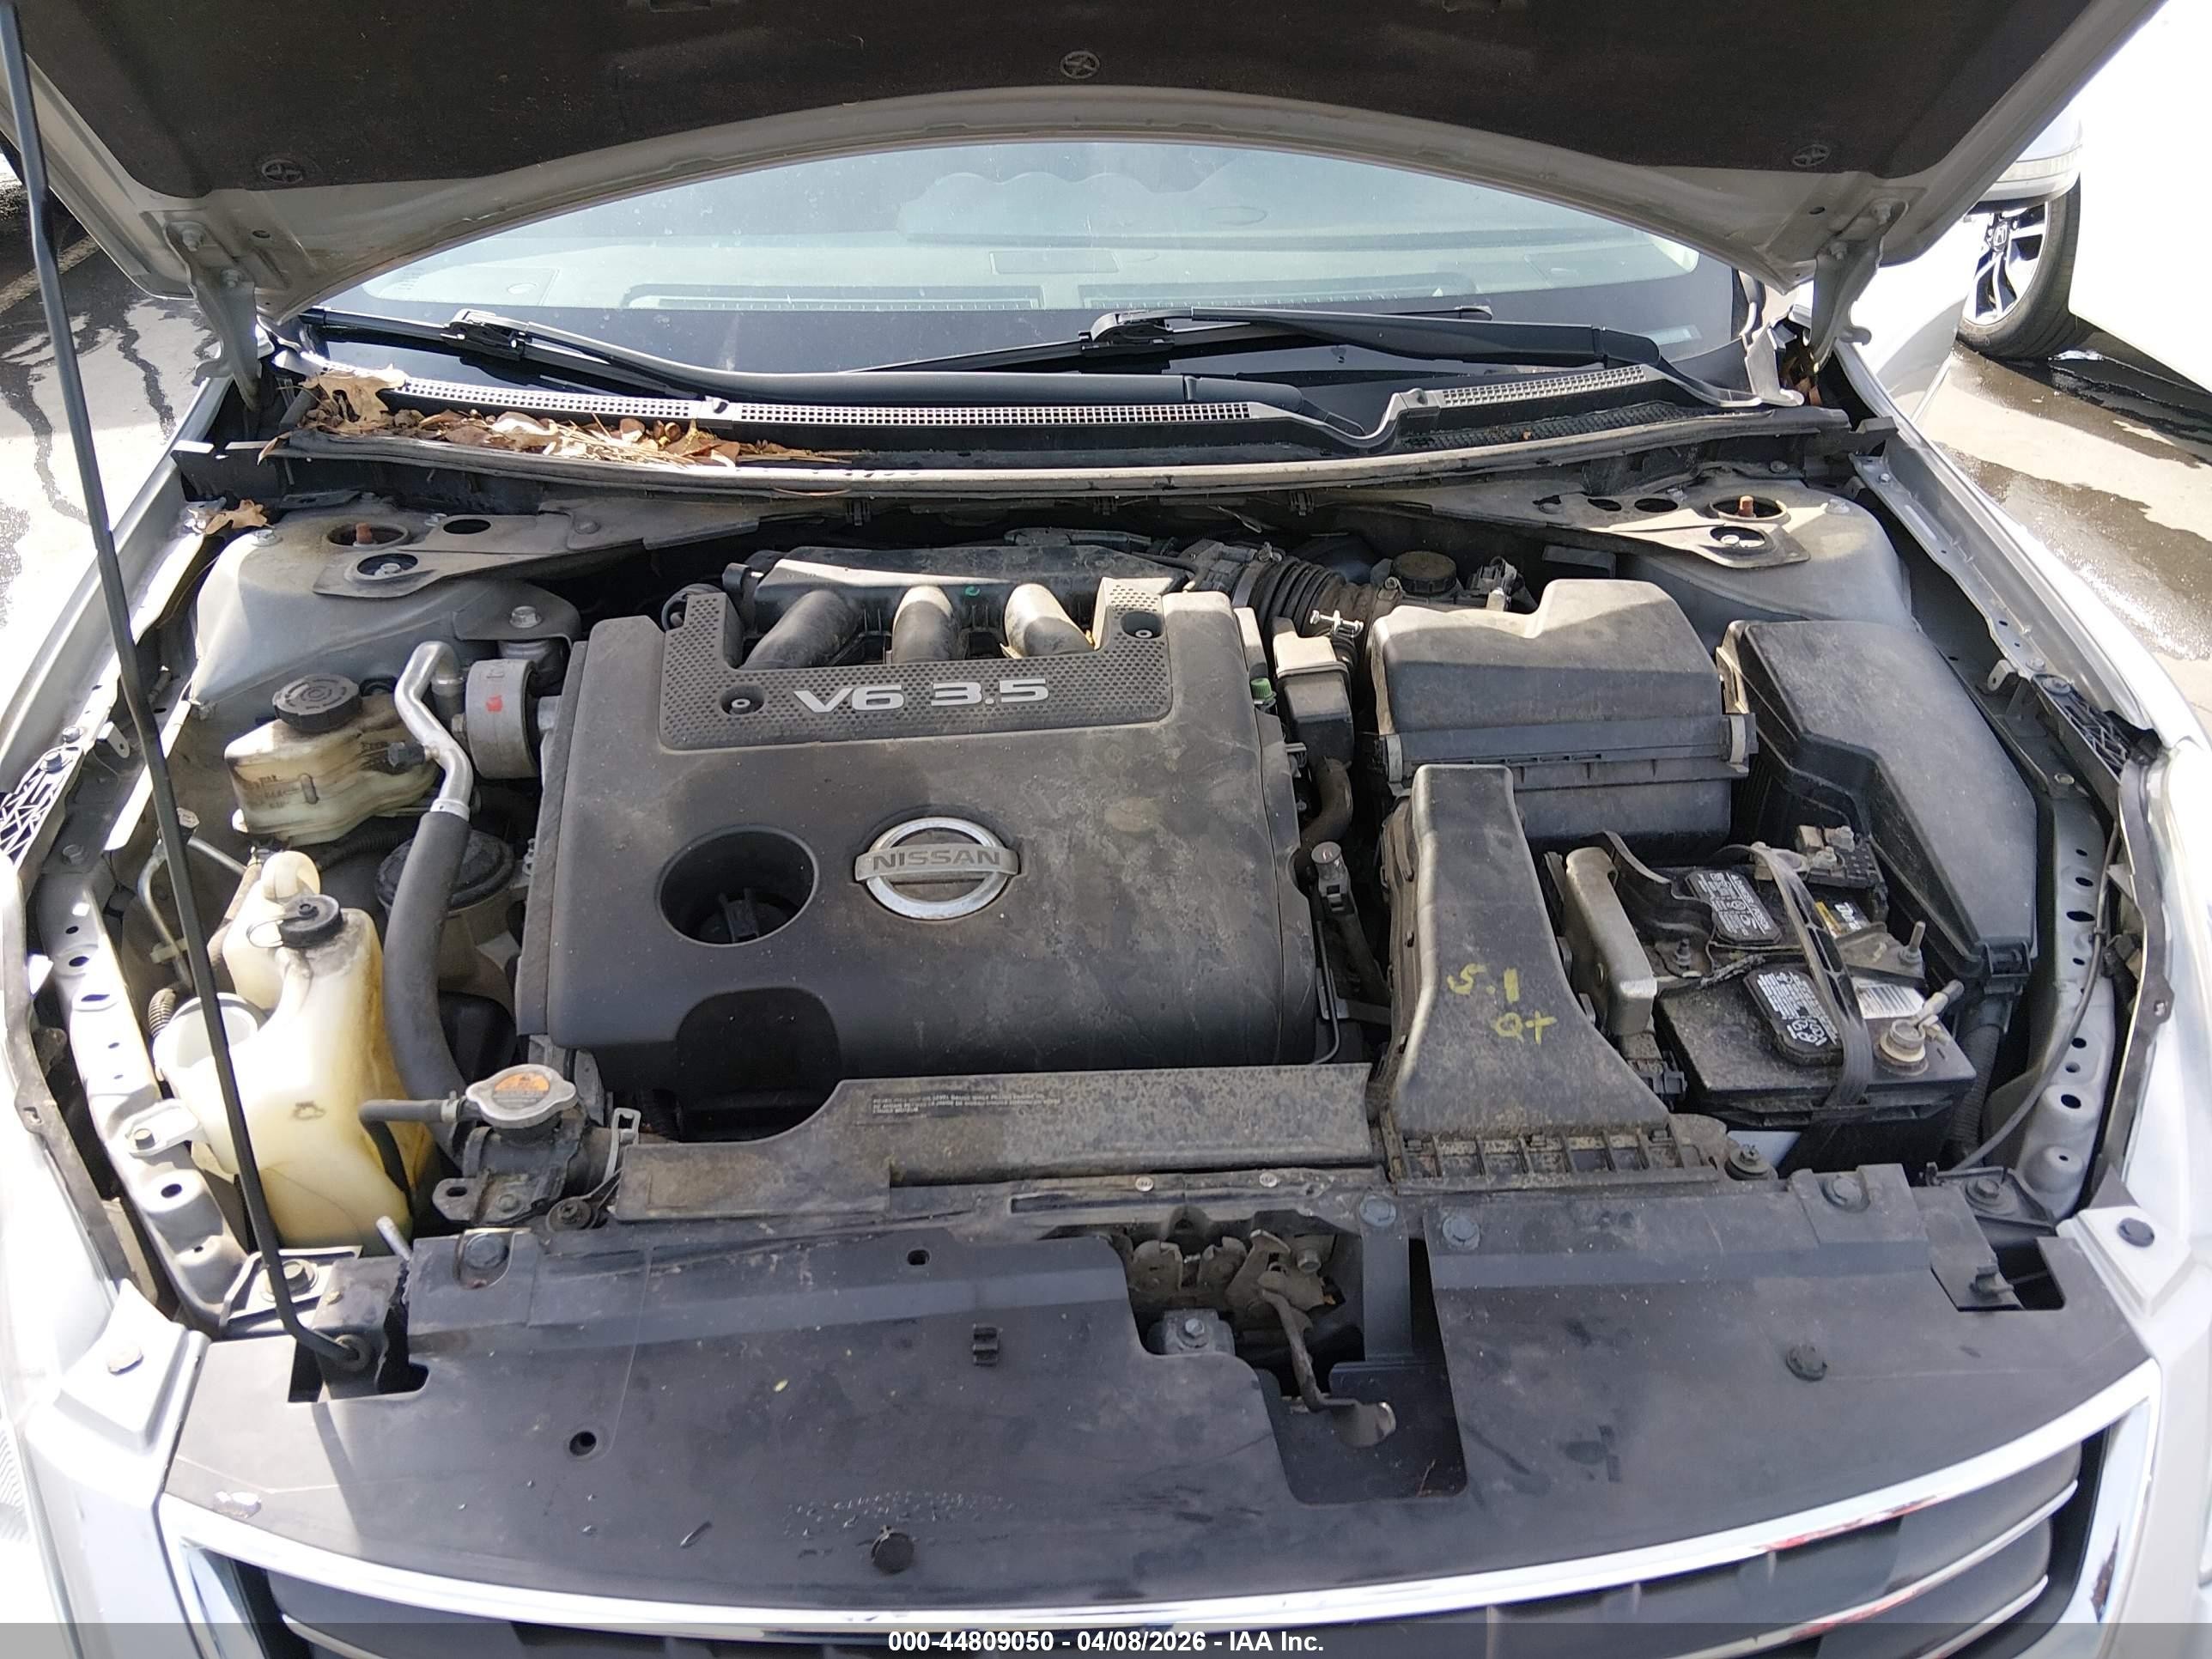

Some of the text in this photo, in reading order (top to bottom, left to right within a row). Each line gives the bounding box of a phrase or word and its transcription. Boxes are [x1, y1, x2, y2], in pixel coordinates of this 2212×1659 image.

[793, 678, 1049, 714] V6 3.5
[872, 848, 1001, 872] NISSAN
